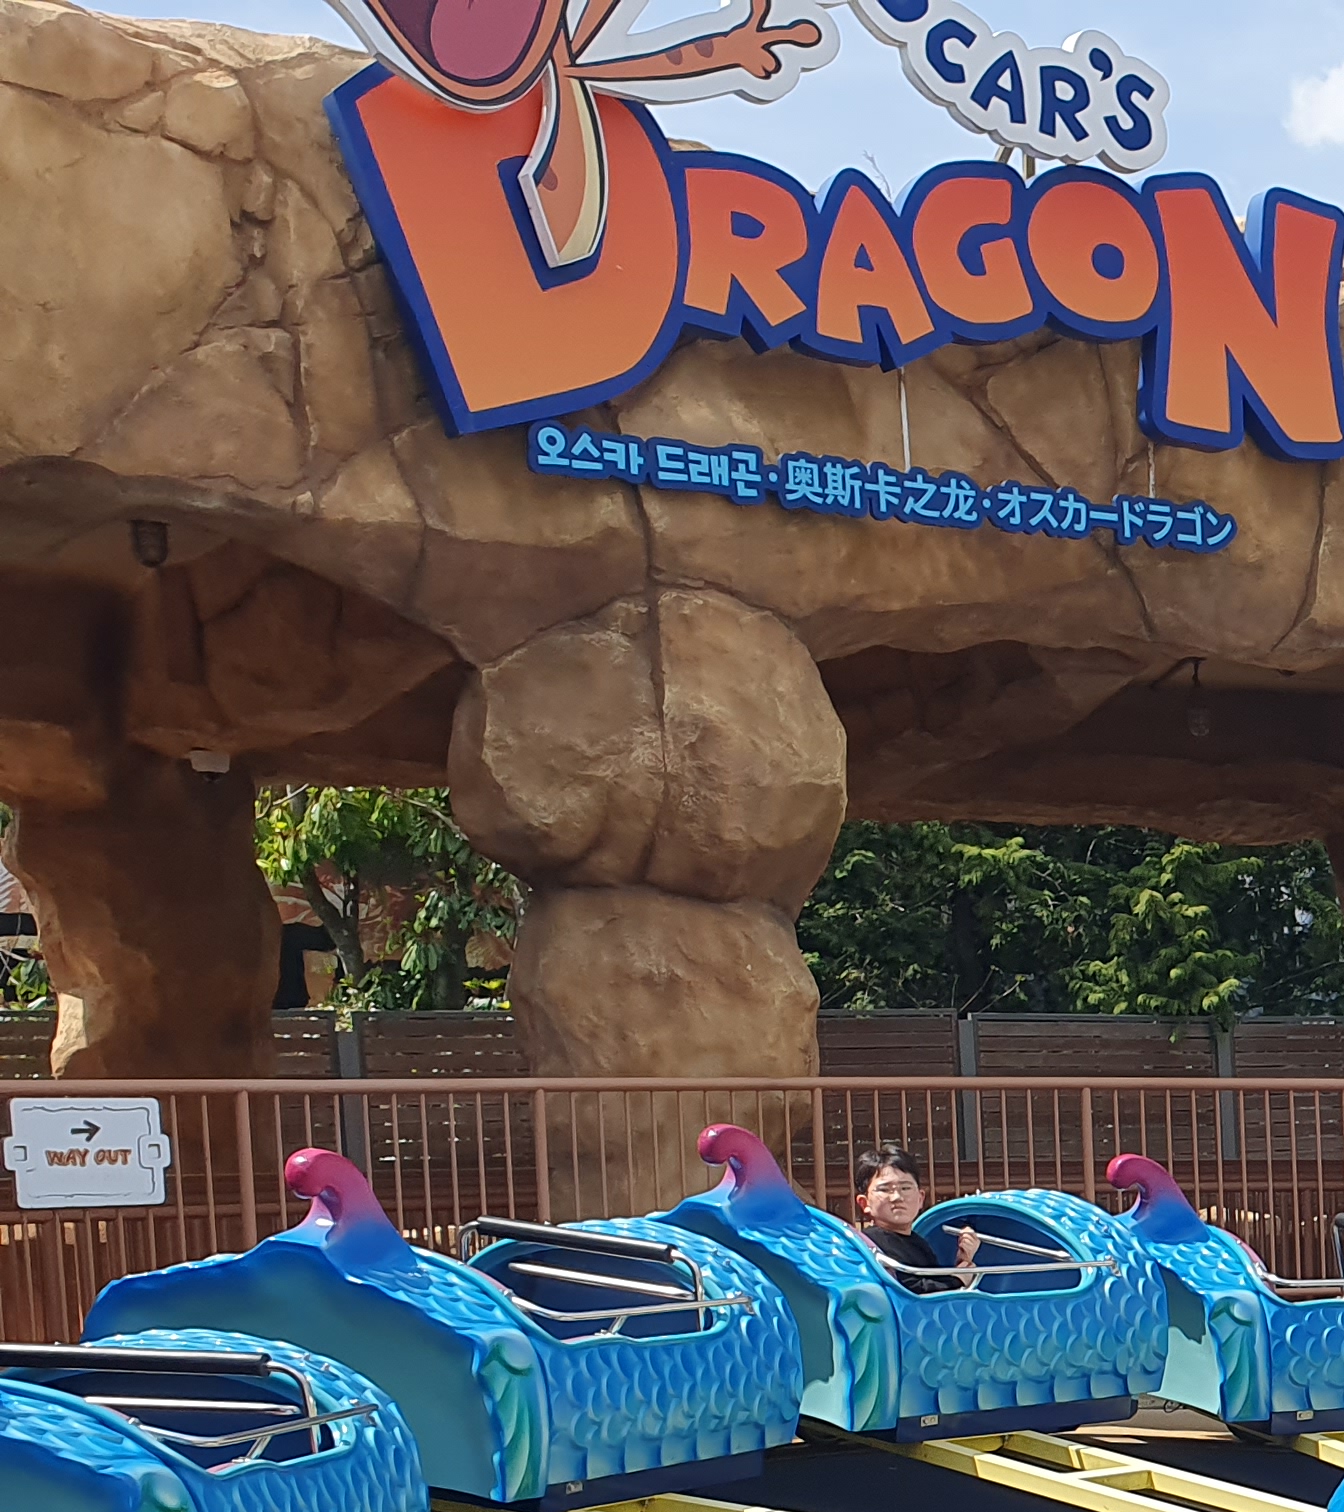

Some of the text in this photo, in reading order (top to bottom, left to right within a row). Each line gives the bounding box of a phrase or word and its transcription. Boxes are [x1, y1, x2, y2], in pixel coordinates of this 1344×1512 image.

[350, 68, 1341, 447] DRAGON
[536, 425, 762, 497] 오스카 드래곤
[784, 458, 979, 523] 奥斯卡之龙
[996, 485, 1234, 546] オスカードラゴン
[45, 1148, 132, 1167] WAY OUT
